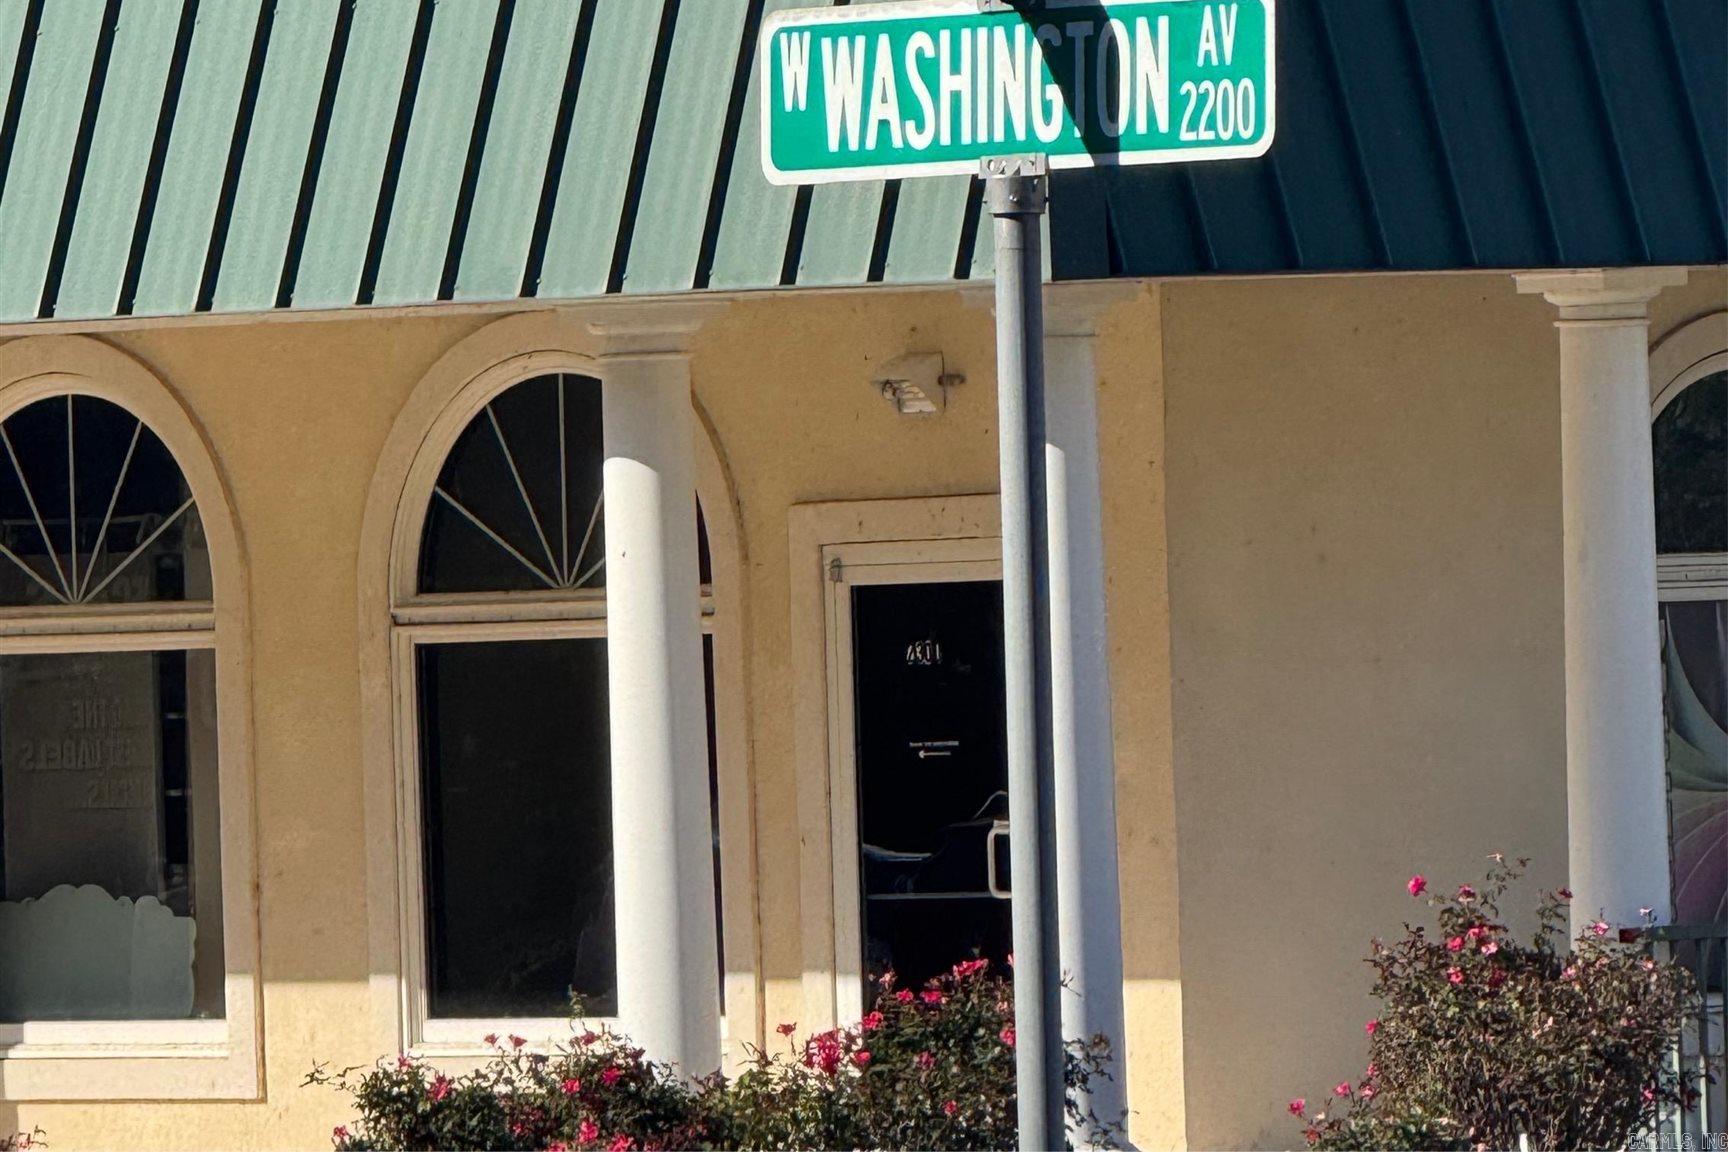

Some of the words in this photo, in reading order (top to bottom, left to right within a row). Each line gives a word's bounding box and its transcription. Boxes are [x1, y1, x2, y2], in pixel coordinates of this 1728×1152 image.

[780, 31, 811, 113] W
[820, 15, 1170, 152] WASHINGTON
[1197, 3, 1238, 67] AV
[1179, 77, 1256, 142] 2200
